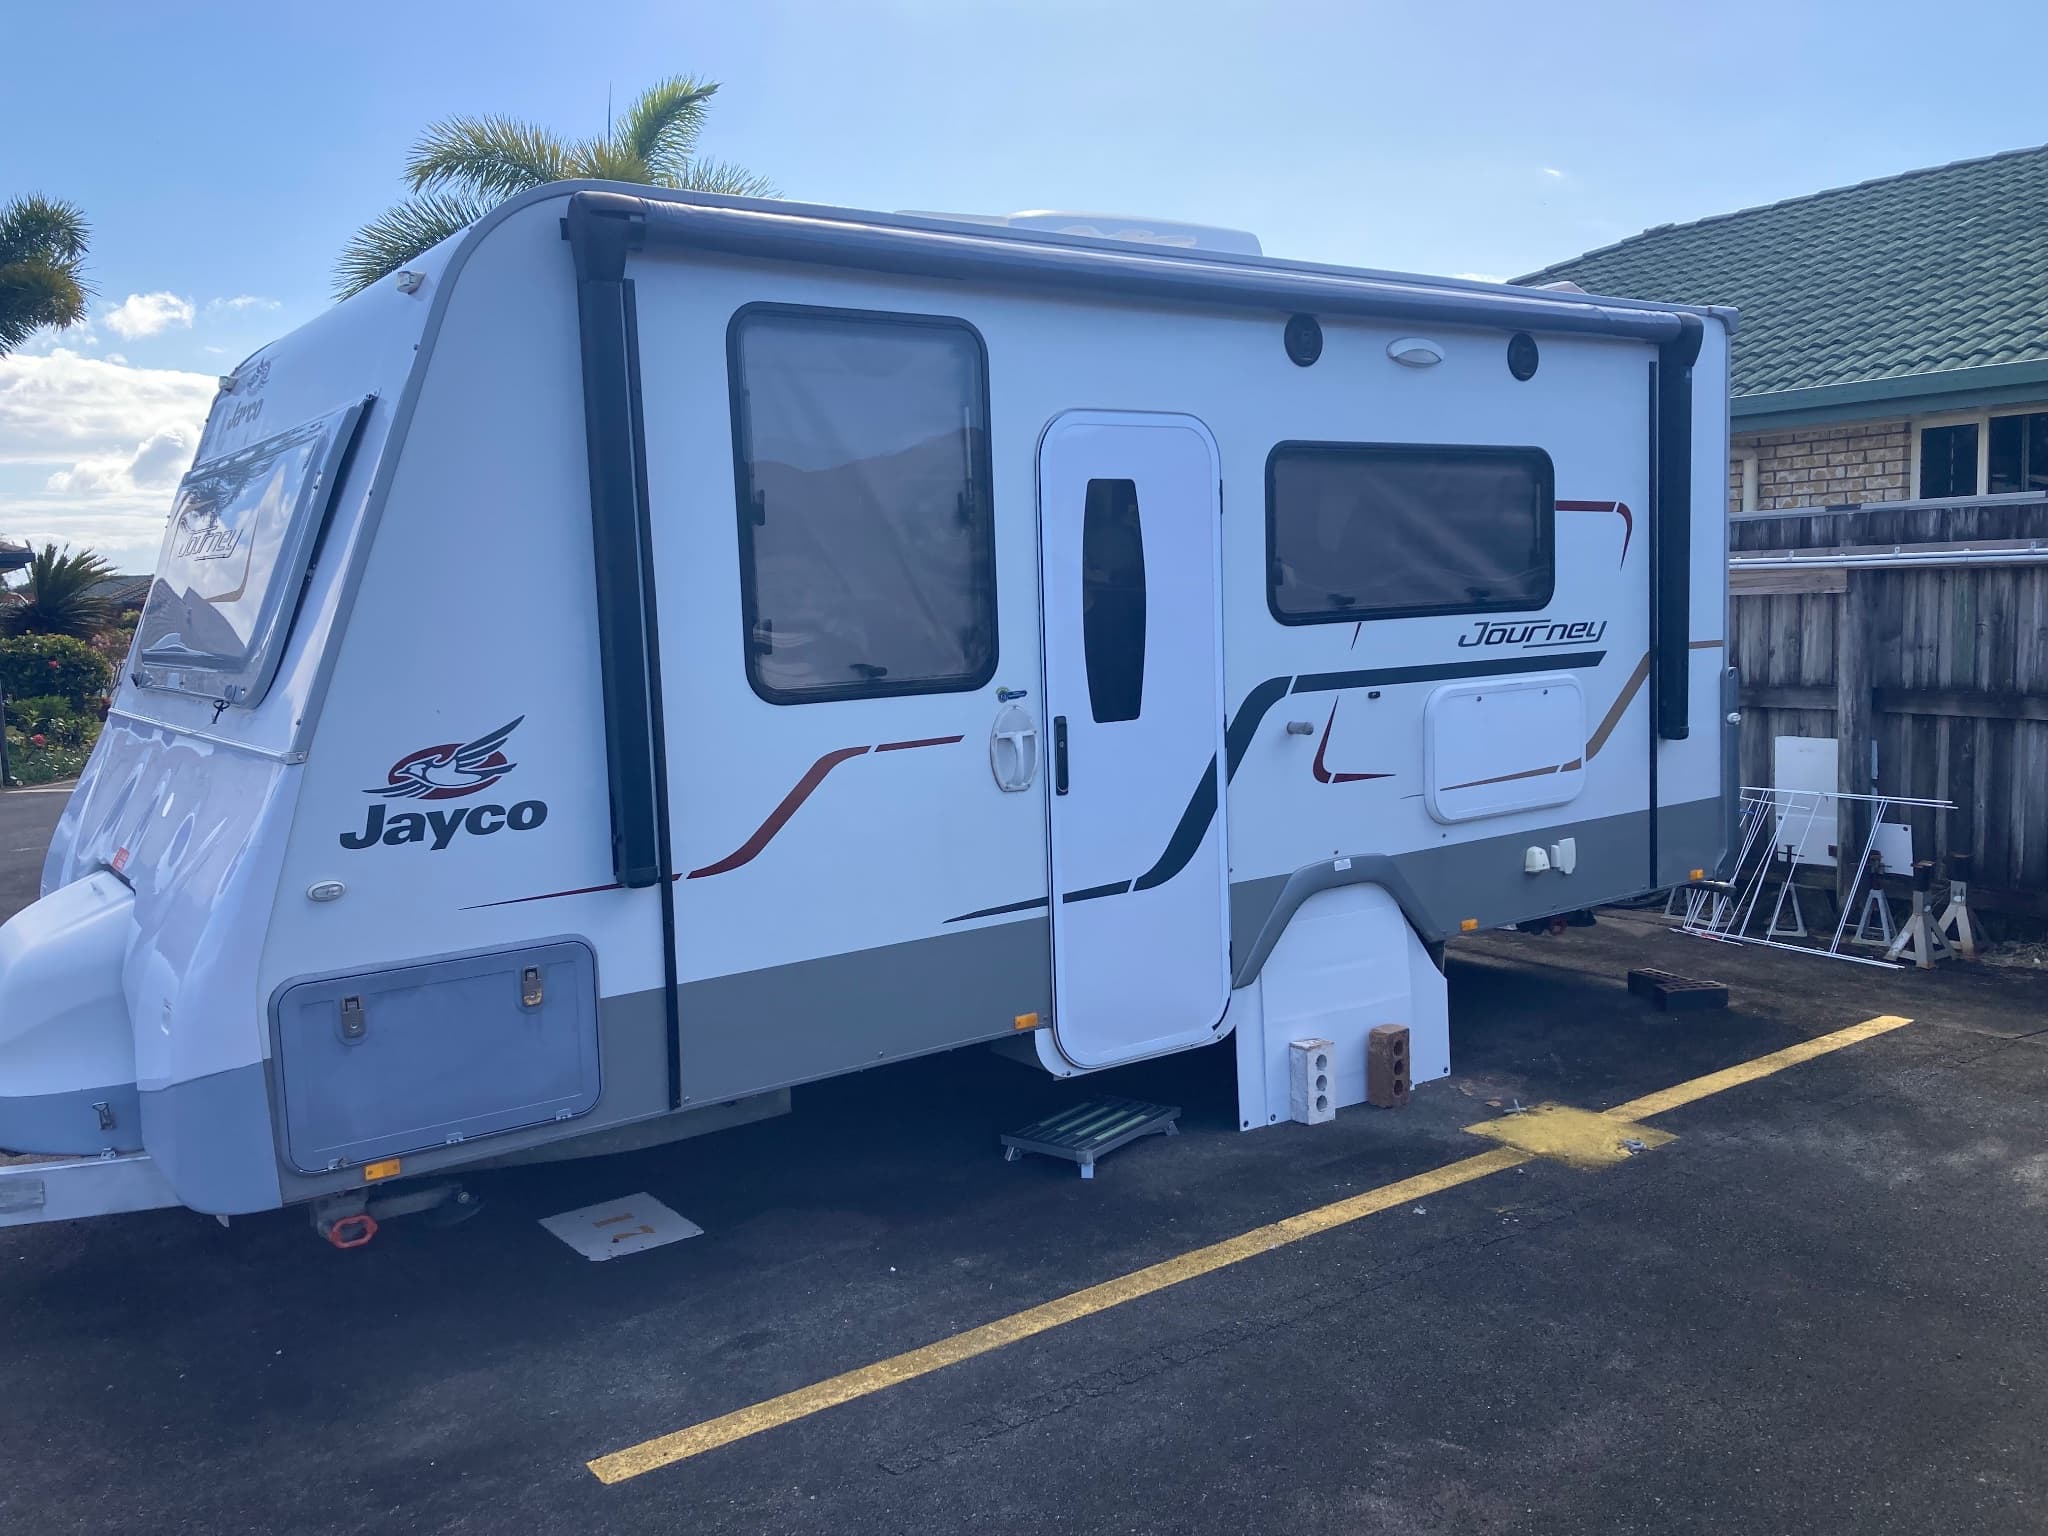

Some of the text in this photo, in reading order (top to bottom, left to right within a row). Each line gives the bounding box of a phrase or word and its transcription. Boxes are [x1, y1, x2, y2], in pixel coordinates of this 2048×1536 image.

[177, 526, 244, 561] Journey
[1458, 619, 1608, 649] Journey
[339, 800, 548, 850] Jayco
